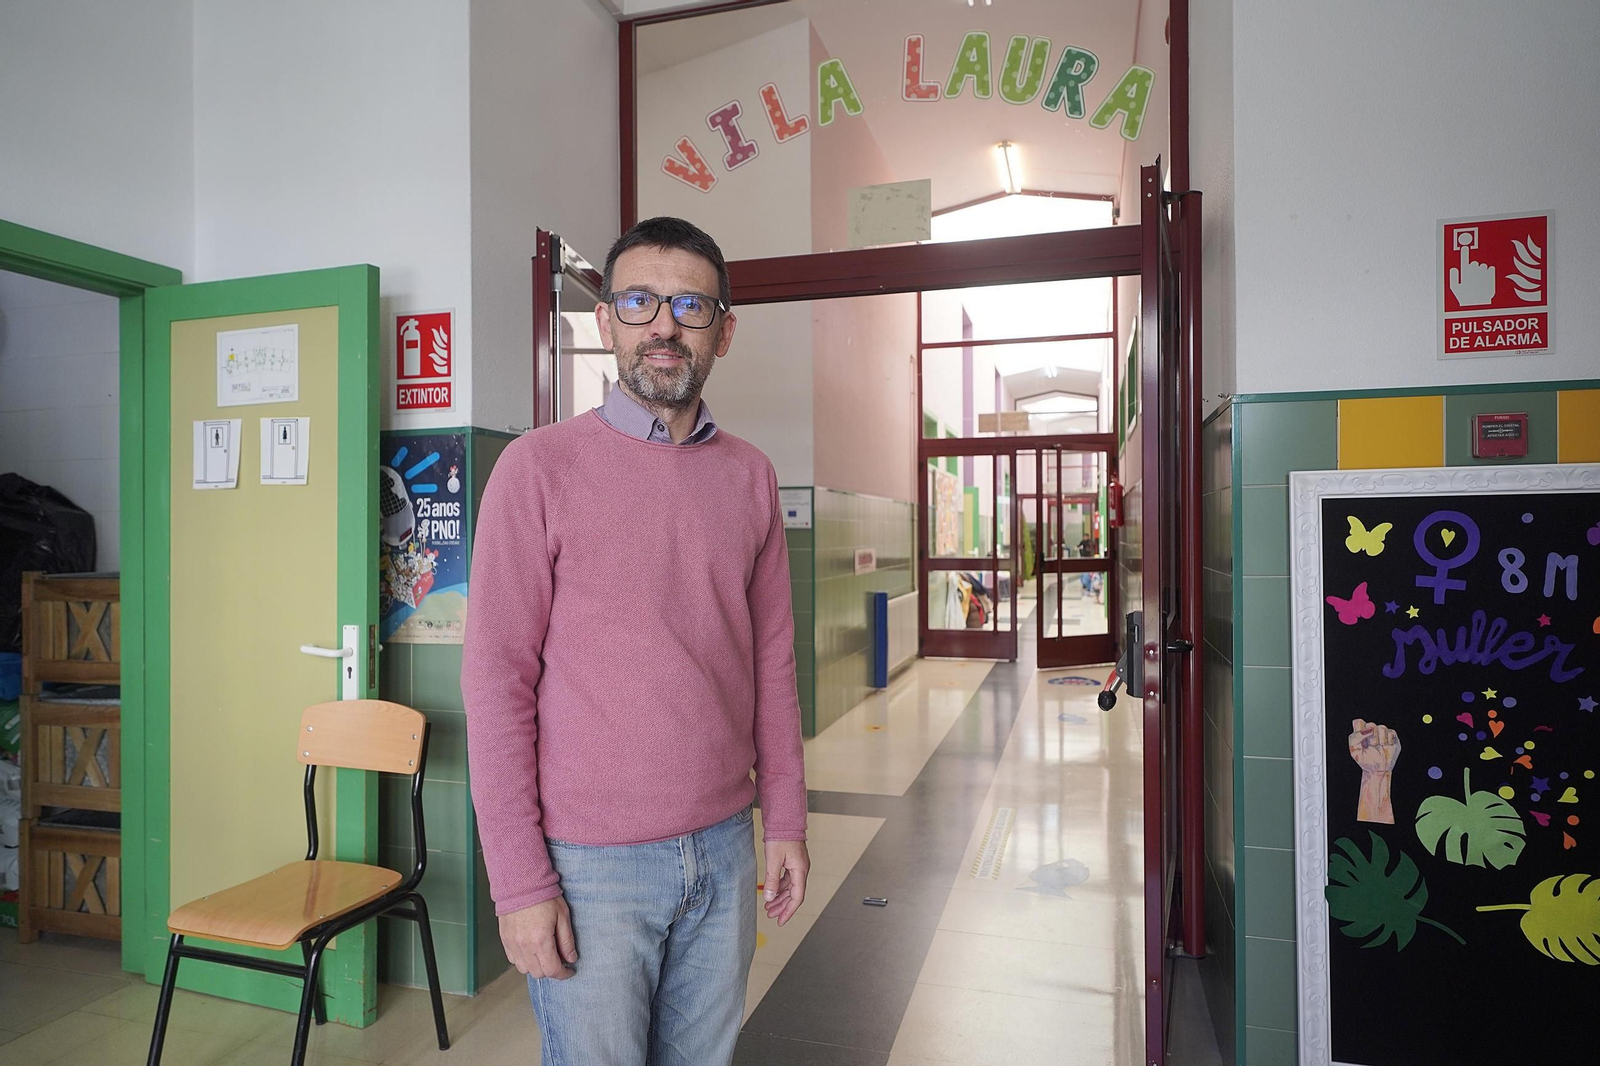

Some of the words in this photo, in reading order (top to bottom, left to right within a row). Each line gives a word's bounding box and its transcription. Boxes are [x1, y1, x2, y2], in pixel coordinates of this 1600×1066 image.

[660, 57, 864, 194] VILA
[902, 30, 1156, 141] LAURA
[1452, 318, 1539, 334] PULSADOR
[1450, 336, 1470, 349] DE
[1474, 333, 1542, 347] ALARMA
[399, 387, 448, 405] EXTINTOR
[416, 497, 431, 517] 25
[431, 502, 460, 517] anos
[431, 519, 460, 540] PNO!
[1498, 548, 1528, 593] 8
[1543, 552, 1579, 601] M
